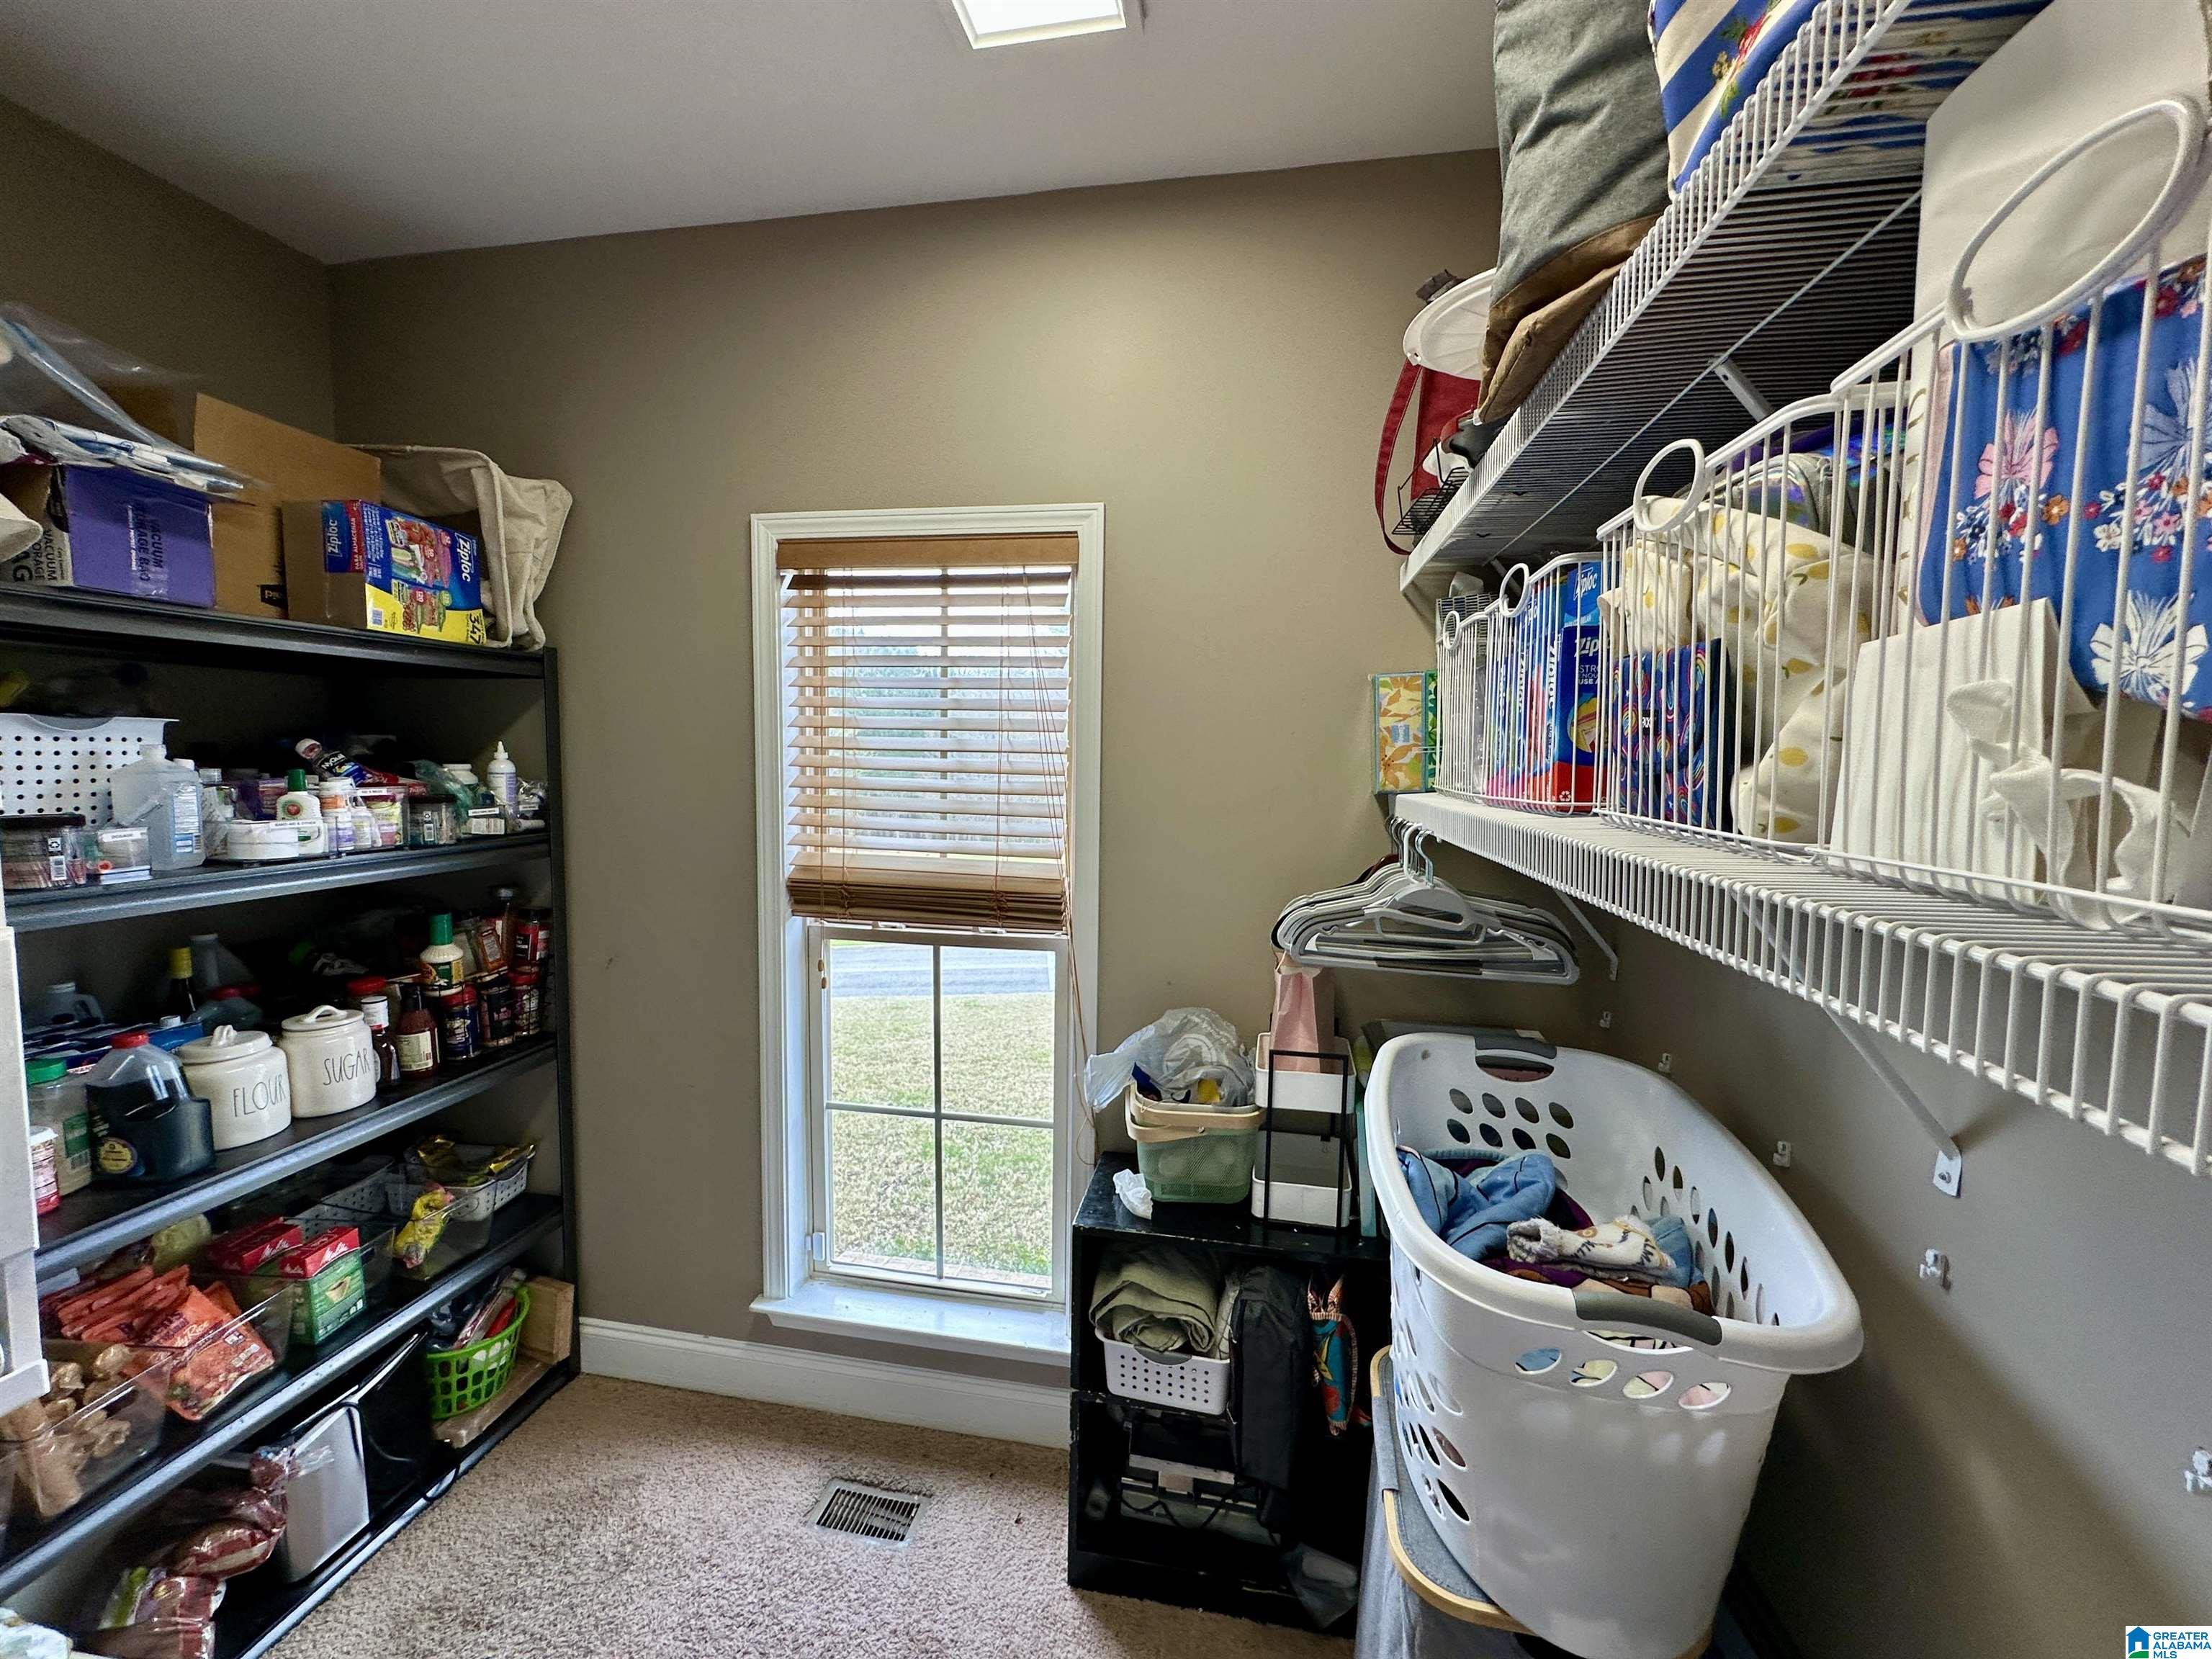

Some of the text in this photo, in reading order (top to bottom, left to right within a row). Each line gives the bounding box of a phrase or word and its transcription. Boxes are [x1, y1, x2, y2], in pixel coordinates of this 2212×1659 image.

[327, 518, 342, 553] Ziploc
[12, 550, 34, 583] AG
[32, 541, 45, 580] ORAGE
[457, 538, 472, 583] Ziploc
[469, 613, 481, 644] 347
[321, 753, 346, 770] NyQuil
[323, 1048, 371, 1086] SUGAR
[233, 1074, 286, 1118] FLOUR
